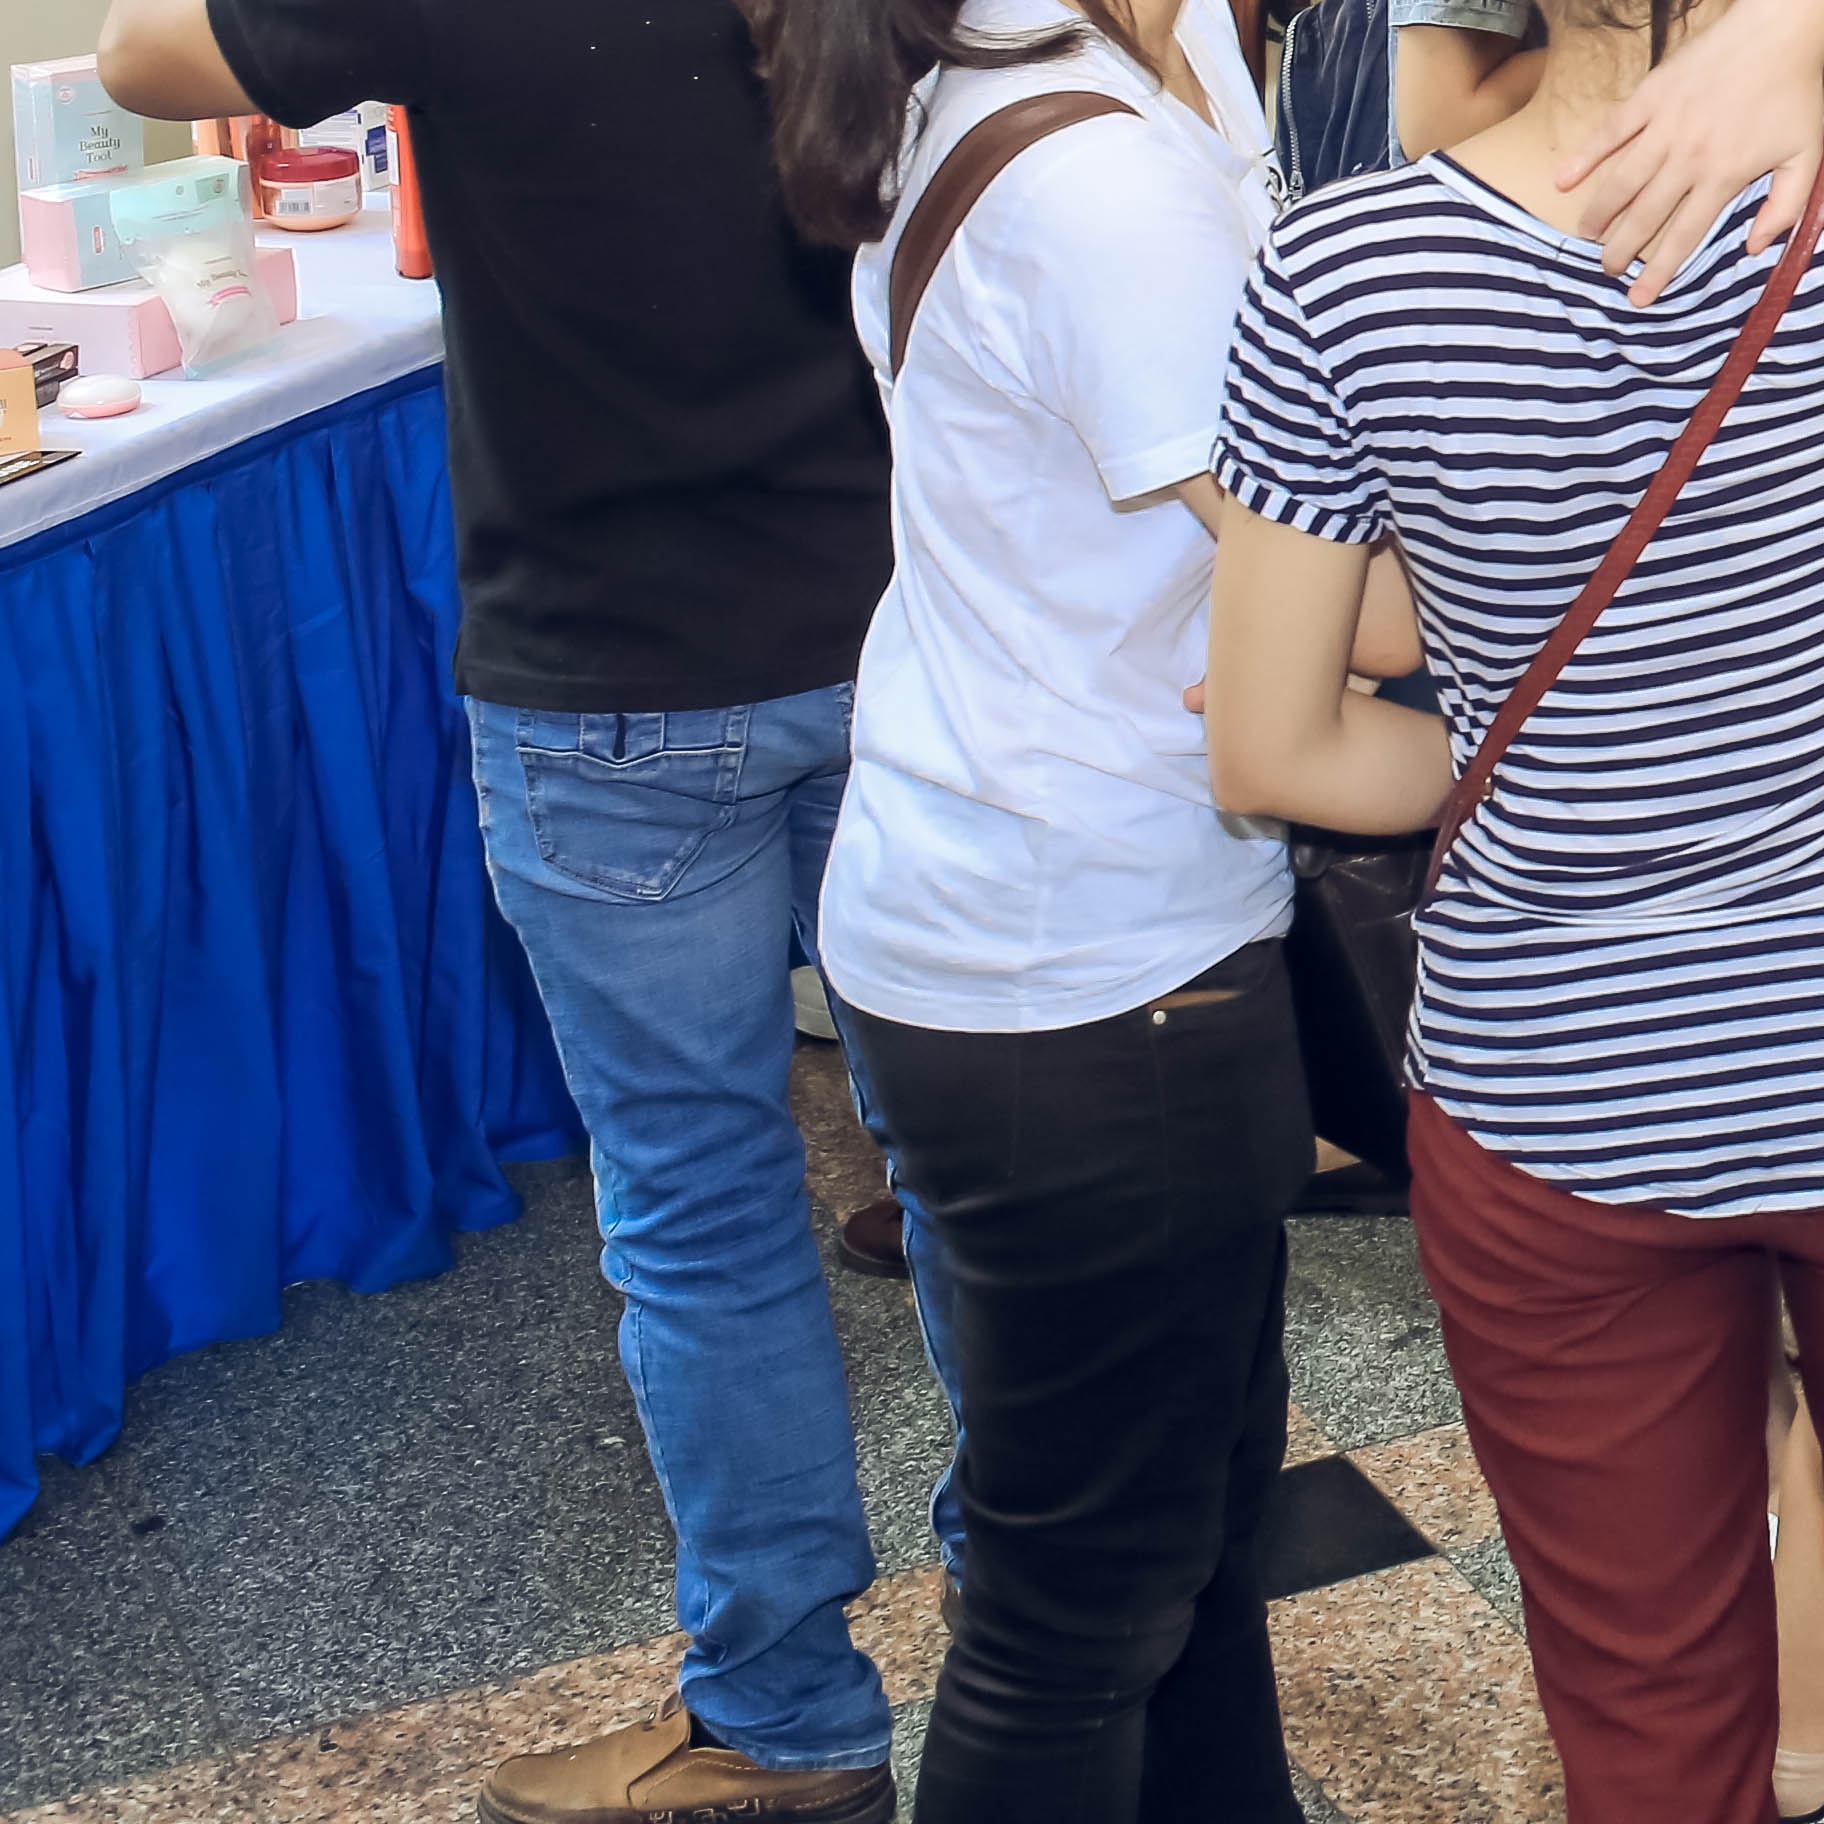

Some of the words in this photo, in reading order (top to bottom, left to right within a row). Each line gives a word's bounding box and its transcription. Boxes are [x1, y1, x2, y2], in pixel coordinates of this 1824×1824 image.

[90, 125, 108, 139] My
[80, 137, 121, 152] Beauty
[86, 149, 112, 164] Tool
